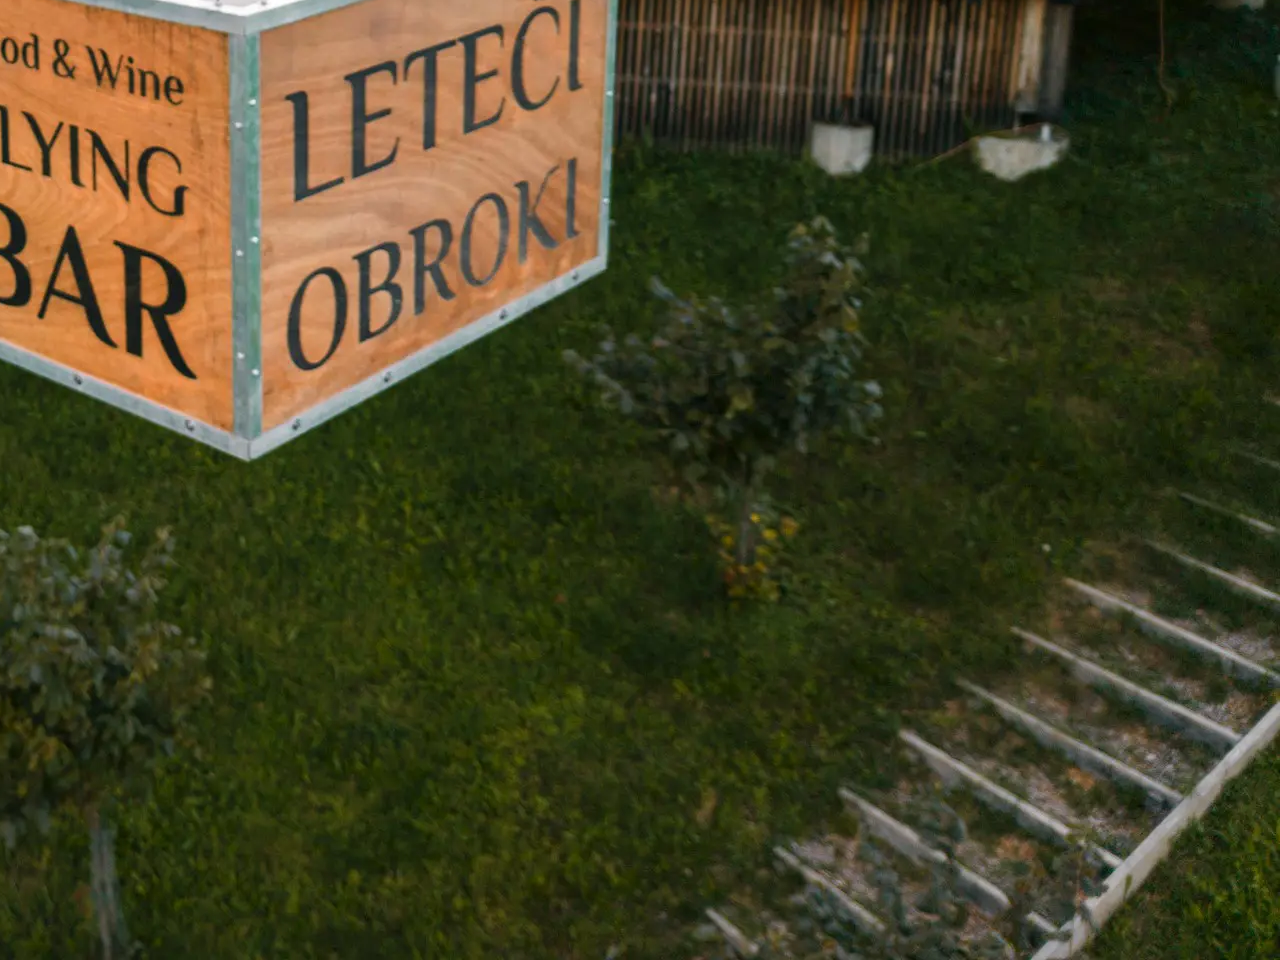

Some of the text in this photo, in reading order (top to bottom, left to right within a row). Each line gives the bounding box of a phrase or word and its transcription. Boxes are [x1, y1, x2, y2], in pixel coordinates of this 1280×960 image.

[52, 39, 78, 79] &
[86, 45, 186, 106] Wine
[286, 158, 581, 372] OBROKI
